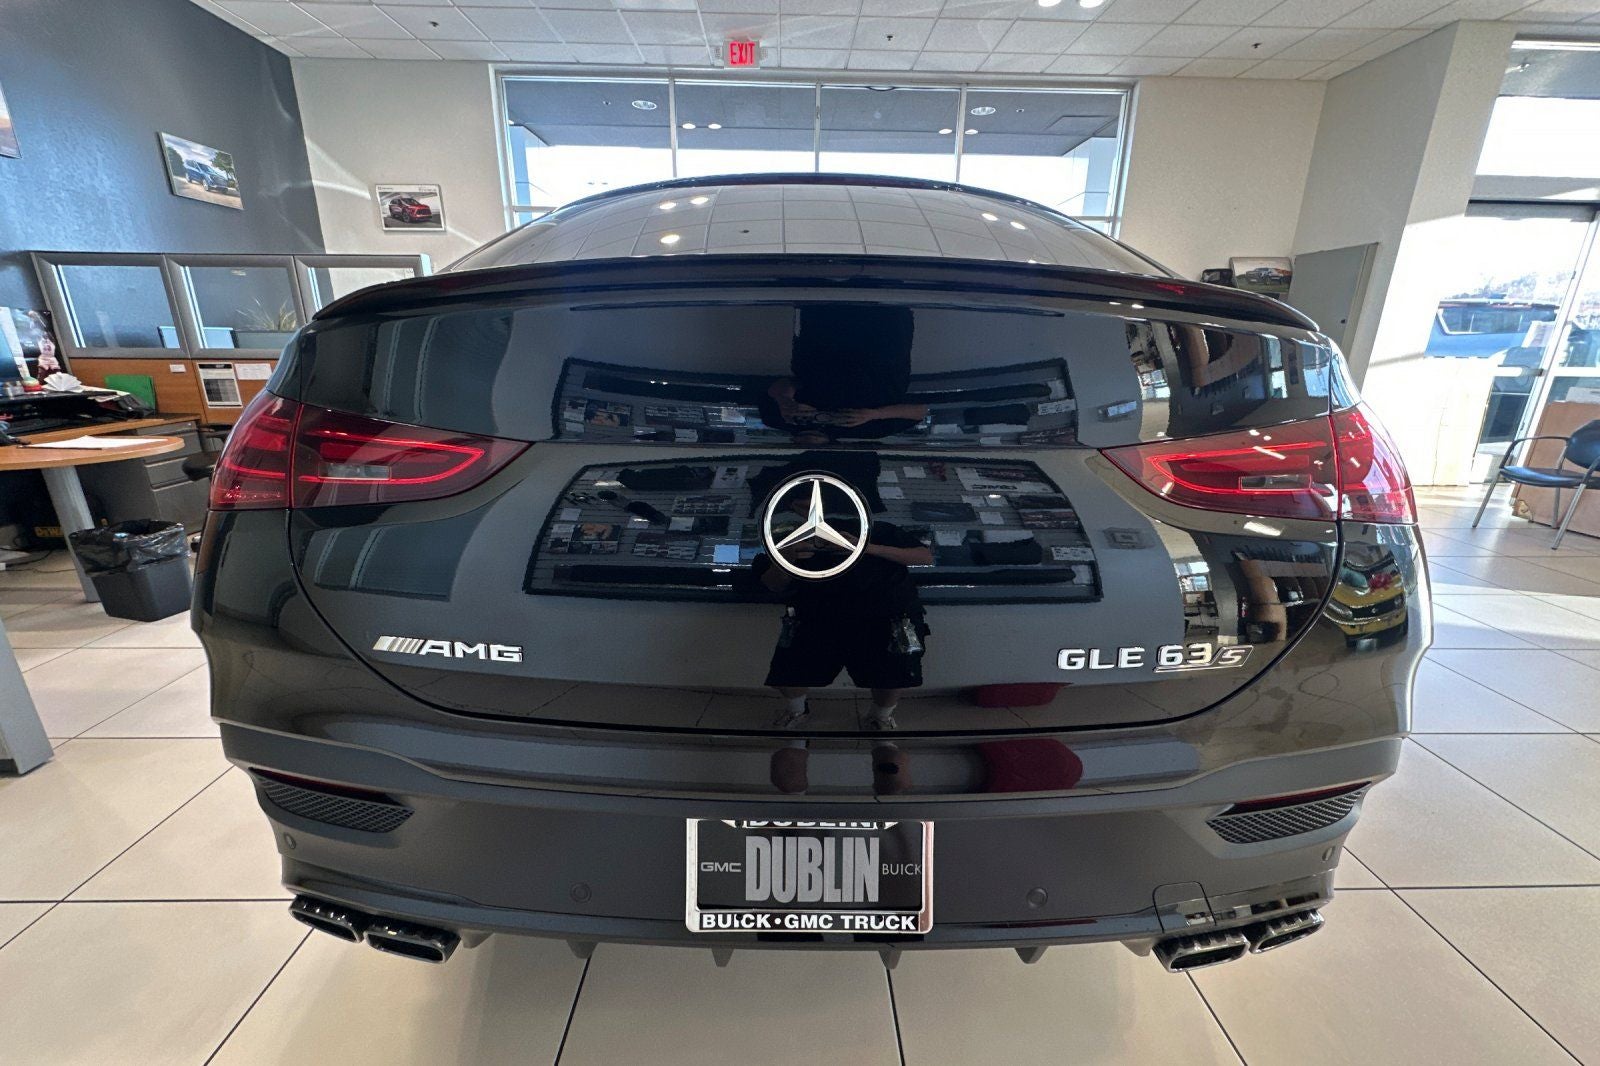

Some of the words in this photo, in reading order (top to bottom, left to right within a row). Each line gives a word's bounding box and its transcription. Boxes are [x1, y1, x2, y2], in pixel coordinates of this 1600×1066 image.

[729, 41, 755, 66] EXIT
[419, 639, 523, 663] AMG
[1057, 647, 1146, 670] GLE
[700, 861, 742, 873] GMC
[745, 835, 880, 903] DUBLIN
[882, 863, 921, 875] BUICK
[840, 914, 916, 930] TRUCK
